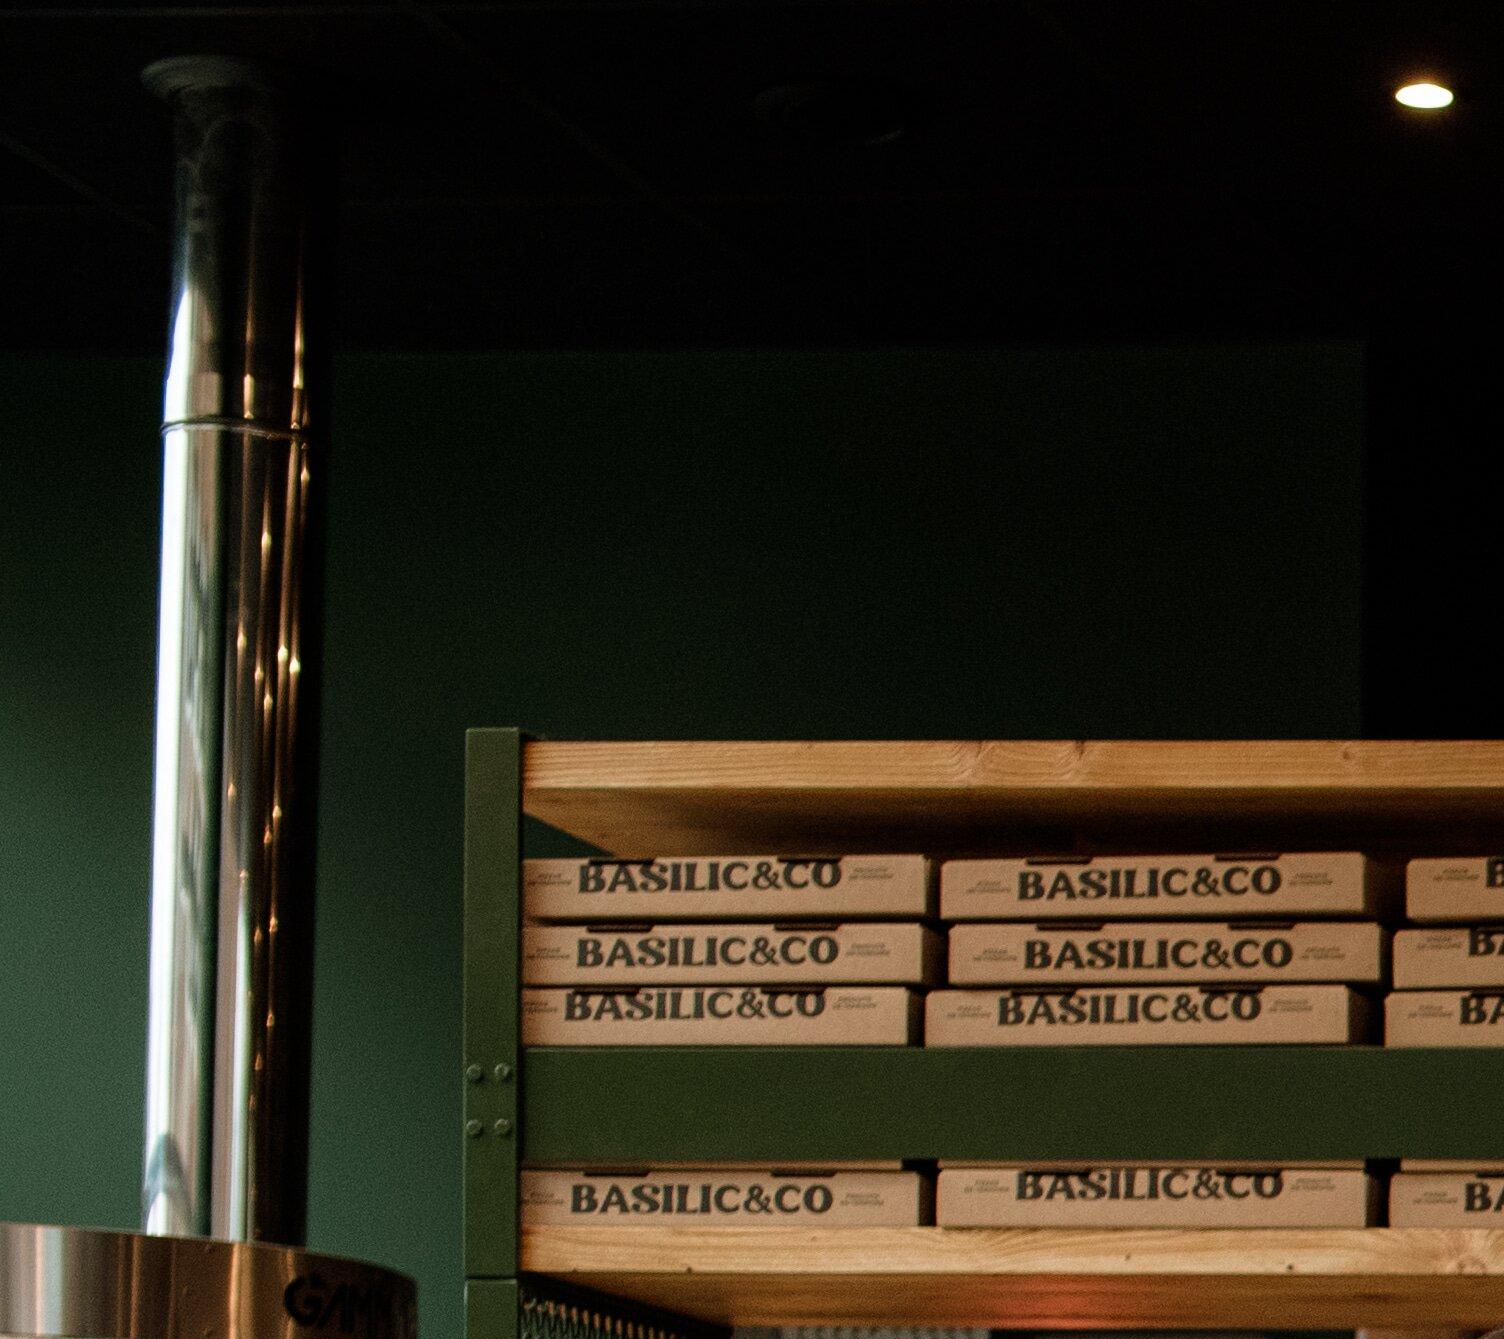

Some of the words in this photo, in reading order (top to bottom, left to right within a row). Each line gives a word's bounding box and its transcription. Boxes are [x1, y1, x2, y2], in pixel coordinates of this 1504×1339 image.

[578, 860, 842, 895] BASILIC&CO
[1018, 865, 1281, 900] BASILIC&CO
[577, 935, 839, 968] BASILIC&CO
[1024, 937, 1293, 970] BASILIC&CO
[564, 988, 825, 1022] BASILIC&CO
[998, 990, 1262, 1026] BASILIC&CO
[571, 1183, 833, 1214] BASILIC&CO
[1016, 1169, 1283, 1201] BASILIC&CO
